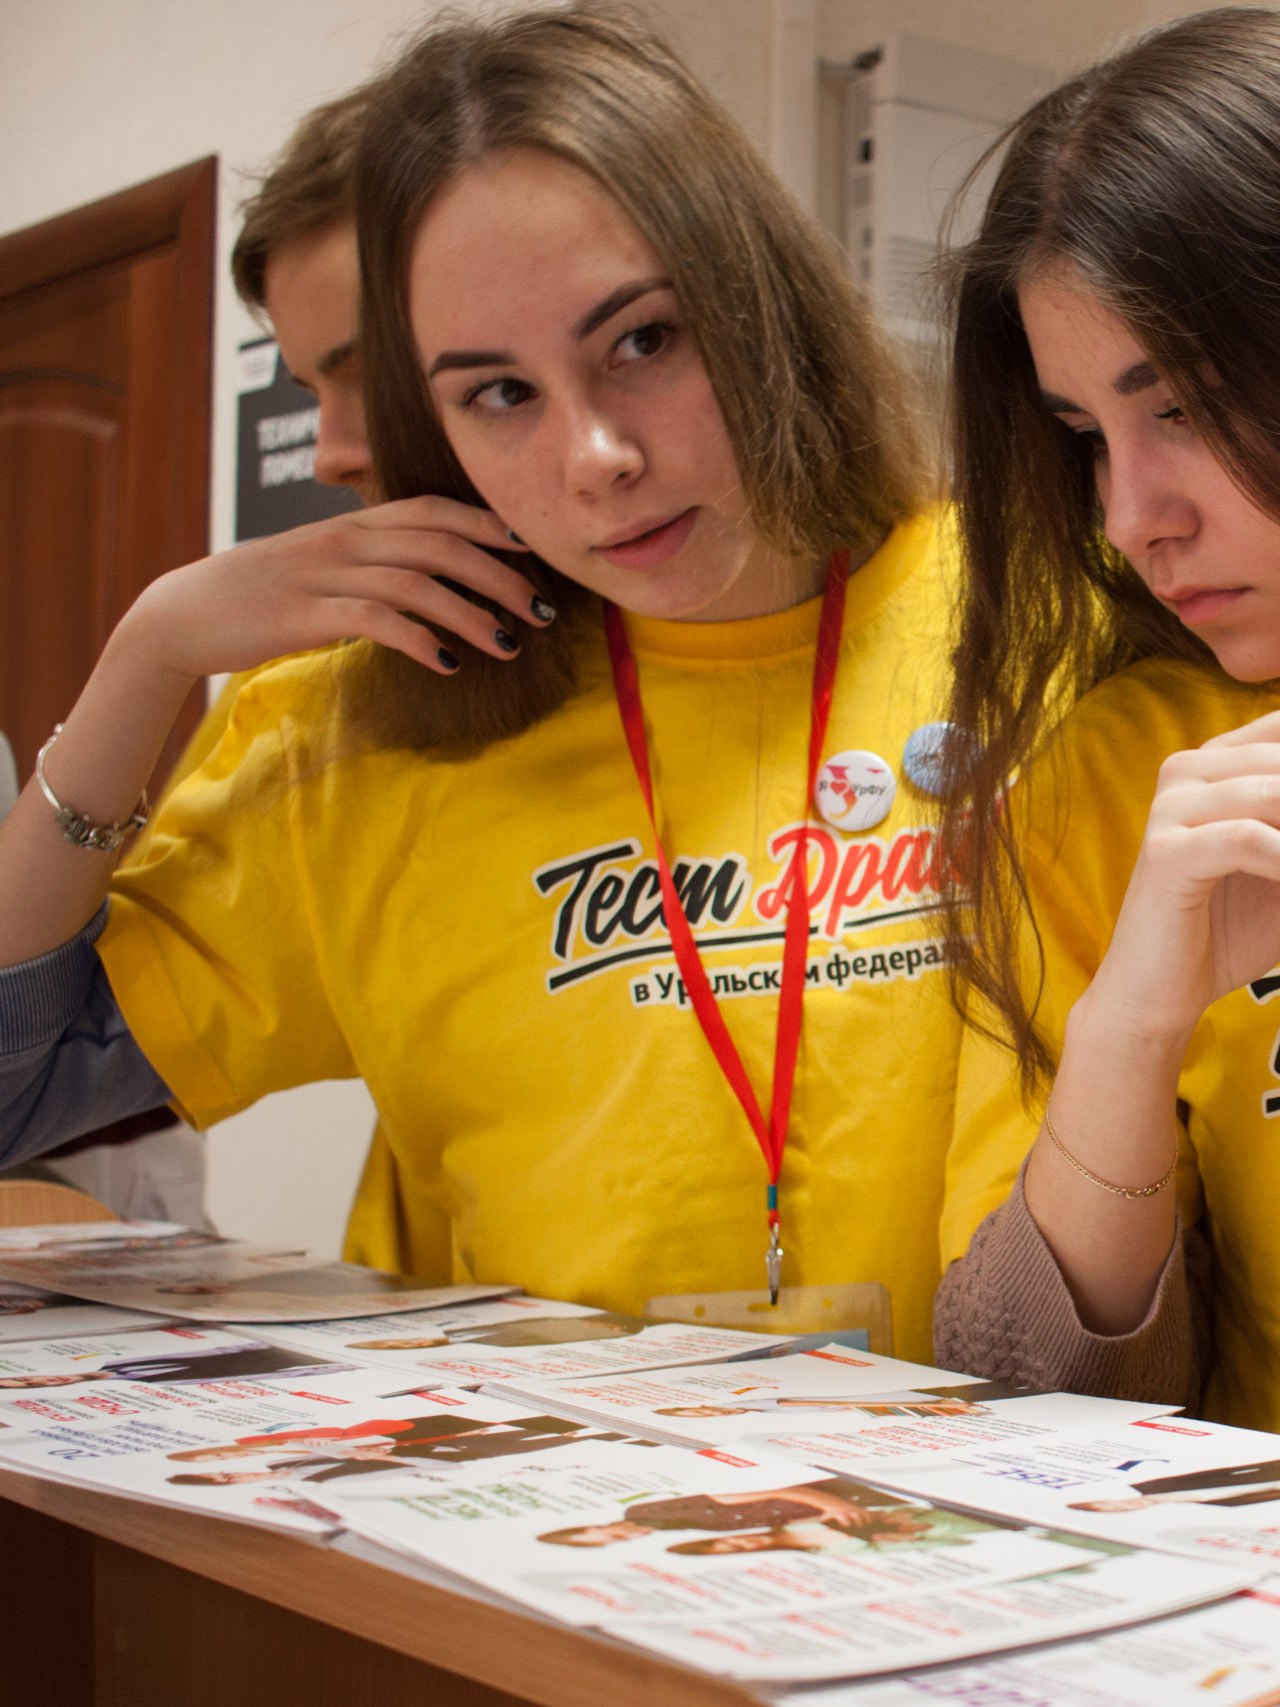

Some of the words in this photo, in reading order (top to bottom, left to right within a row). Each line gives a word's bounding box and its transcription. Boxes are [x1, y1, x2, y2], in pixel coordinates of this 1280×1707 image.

[818, 781, 828, 792] Я
[852, 782, 887, 796] УрФУ
[536, 844, 746, 958] Тест
[634, 983, 650, 1002] в
